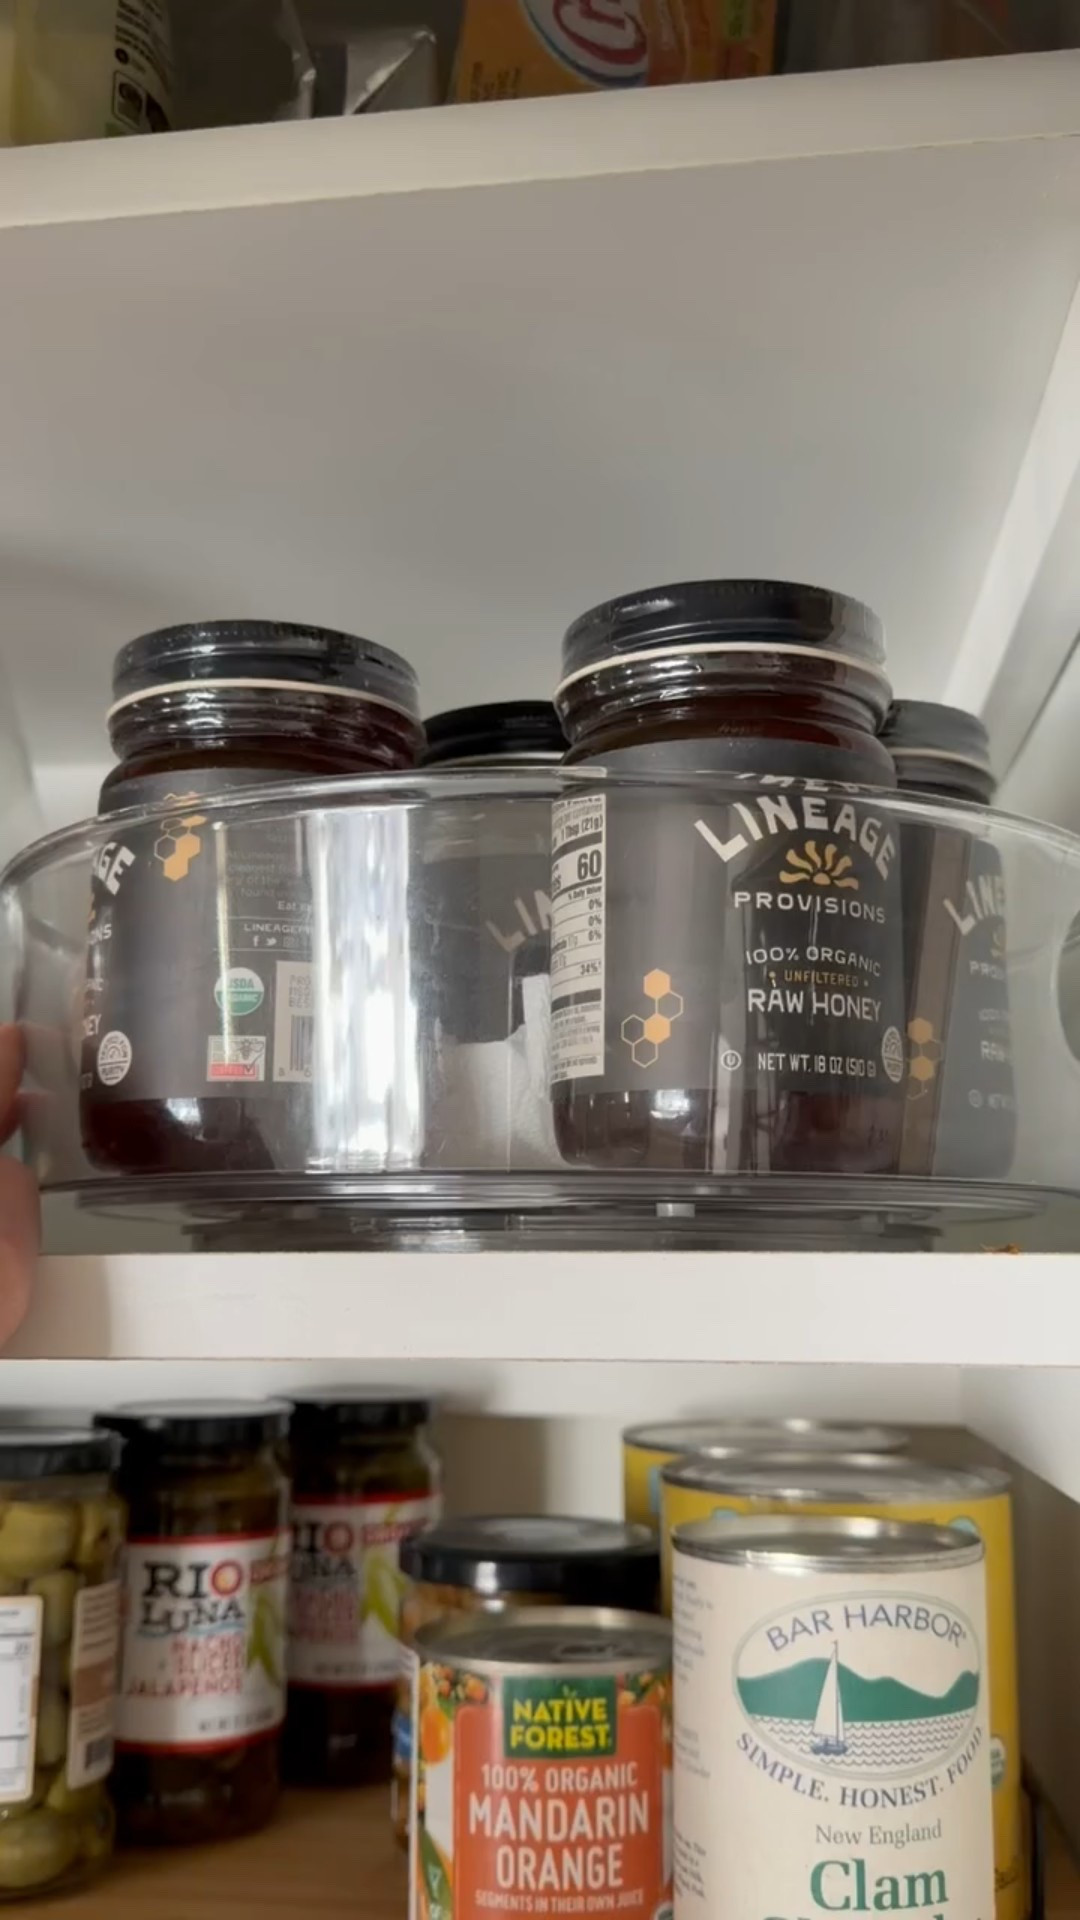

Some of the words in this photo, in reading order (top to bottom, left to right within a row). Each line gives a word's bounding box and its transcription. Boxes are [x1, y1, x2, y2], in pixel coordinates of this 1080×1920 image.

[694, 795, 896, 880] LINEAGE
[577, 849, 602, 881] 60
[734, 892, 886, 924] PROVISIONS
[746, 947, 799, 965] 100%
[806, 946, 881, 977] ORGANIC
[784, 969, 859, 988] UNFILTERED
[748, 988, 804, 1014] RAW
[812, 992, 882, 1021] HONEY
[758, 1053, 786, 1071] NET
[789, 1053, 811, 1072] WT.
[814, 1055, 826, 1073] 18
[829, 1056, 844, 1075] OZ
[142, 1560, 243, 1599] RIO
[142, 1598, 245, 1633] LUNA
[766, 1608, 833, 1652] BAR
[843, 1604, 964, 1648] HARBOR
[513, 1697, 608, 1723] NATIVE
[510, 1724, 611, 1750] FOREST
[481, 1763, 539, 1793] 100%
[545, 1761, 638, 1792] ORGANIC
[735, 1731, 830, 1803] SIMPLE.
[839, 1782, 944, 1809] HONEST.
[947, 1725, 985, 1785] FOOD
[468, 1791, 649, 1843] MANDARIN
[815, 1823, 862, 1845] New
[869, 1819, 942, 1849] England
[496, 1844, 623, 1891] ORANGE
[475, 1888, 532, 1913] SEGMENTS
[534, 1895, 549, 1913] IN
[551, 1895, 585, 1914] THEIR
[586, 1893, 615, 1911] OWN
[616, 1887, 644, 1909] JUICE
[809, 1858, 949, 1912] Clam
